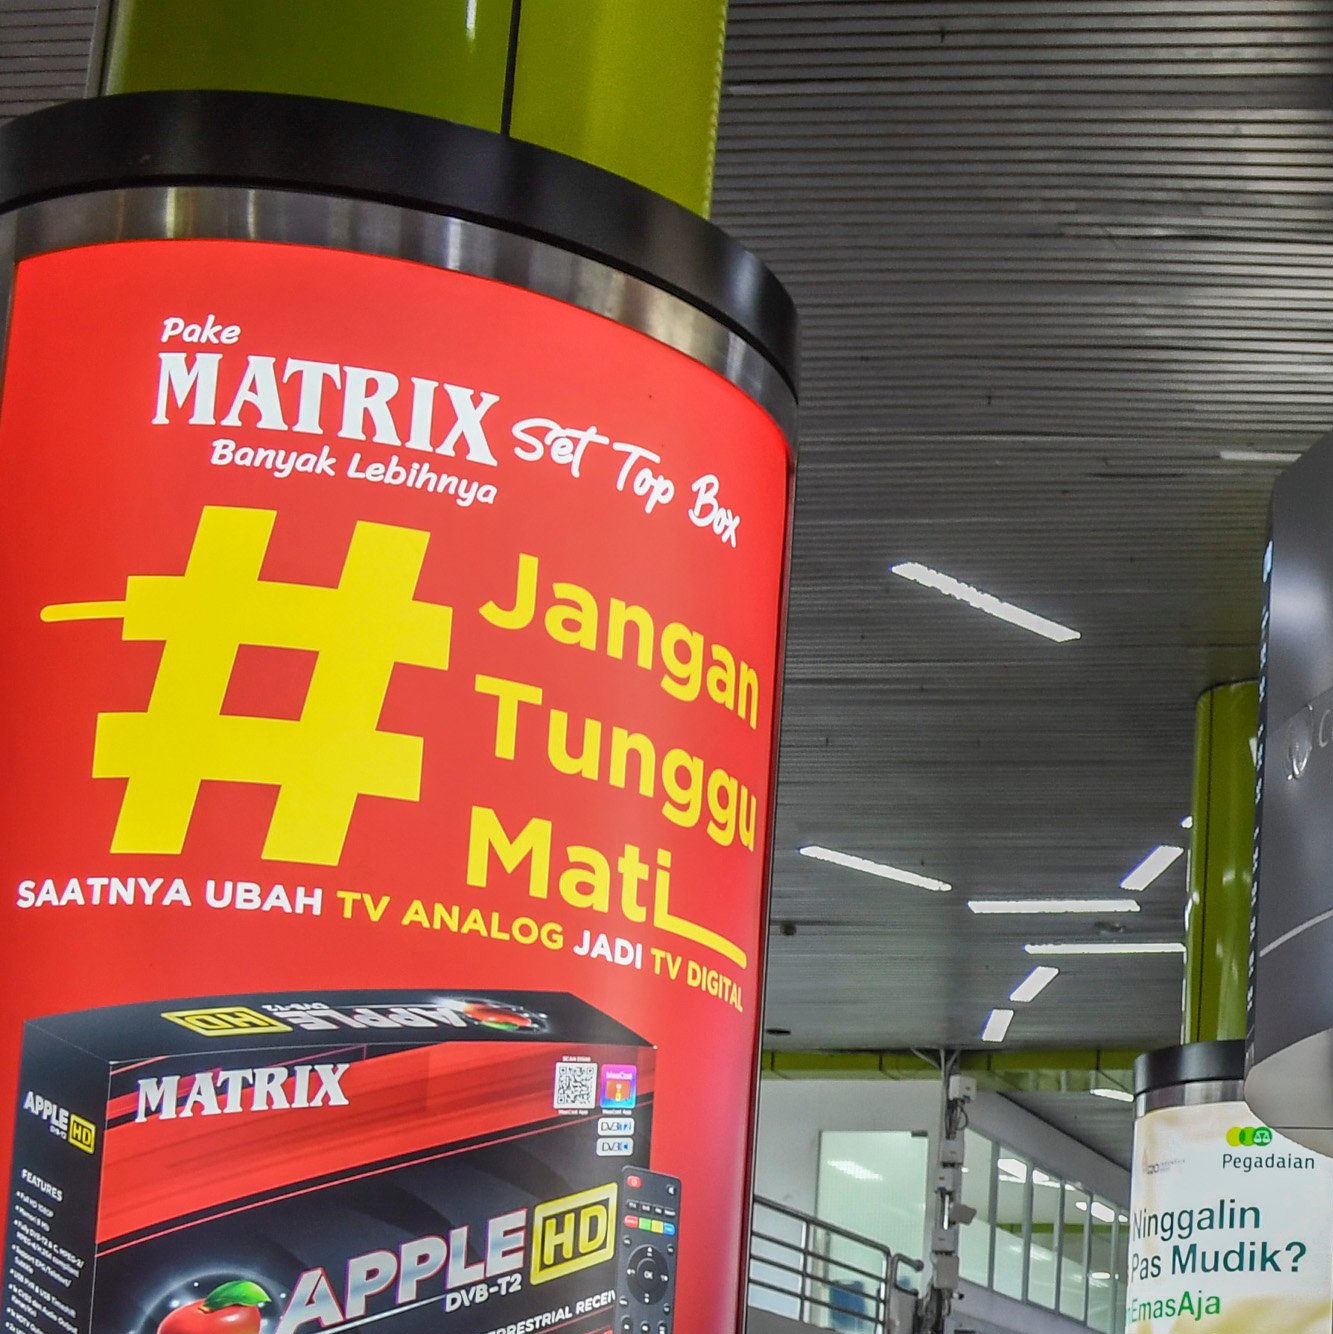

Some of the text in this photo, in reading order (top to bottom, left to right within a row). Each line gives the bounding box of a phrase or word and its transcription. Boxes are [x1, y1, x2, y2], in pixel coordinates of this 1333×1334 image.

[161, 315, 240, 344] Pake
[151, 352, 740, 547] MATRIX Set Top Box
[210, 438, 497, 507] Banyak Lebihnya
[478, 552, 759, 729] Jangan
[40, 505, 454, 867] #
[473, 674, 757, 852] Tunggu
[465, 804, 720, 945] Mati
[16, 878, 744, 1013] SAATNYA UBAH TV ANALOG JADI TV DIGITAL
[24, 1091, 92, 1146] APPLE HD
[135, 1063, 350, 1122] MATRIX
[22, 1168, 62, 1202] FEATURES
[1222, 1153, 1315, 1173] Pegadaian
[544, 1205, 607, 1266] HD
[1133, 1199, 1260, 1240] Ninggalin
[1131, 1240, 1307, 1282] Pas Mudik?
[445, 1273, 522, 1312] DVB-T2
